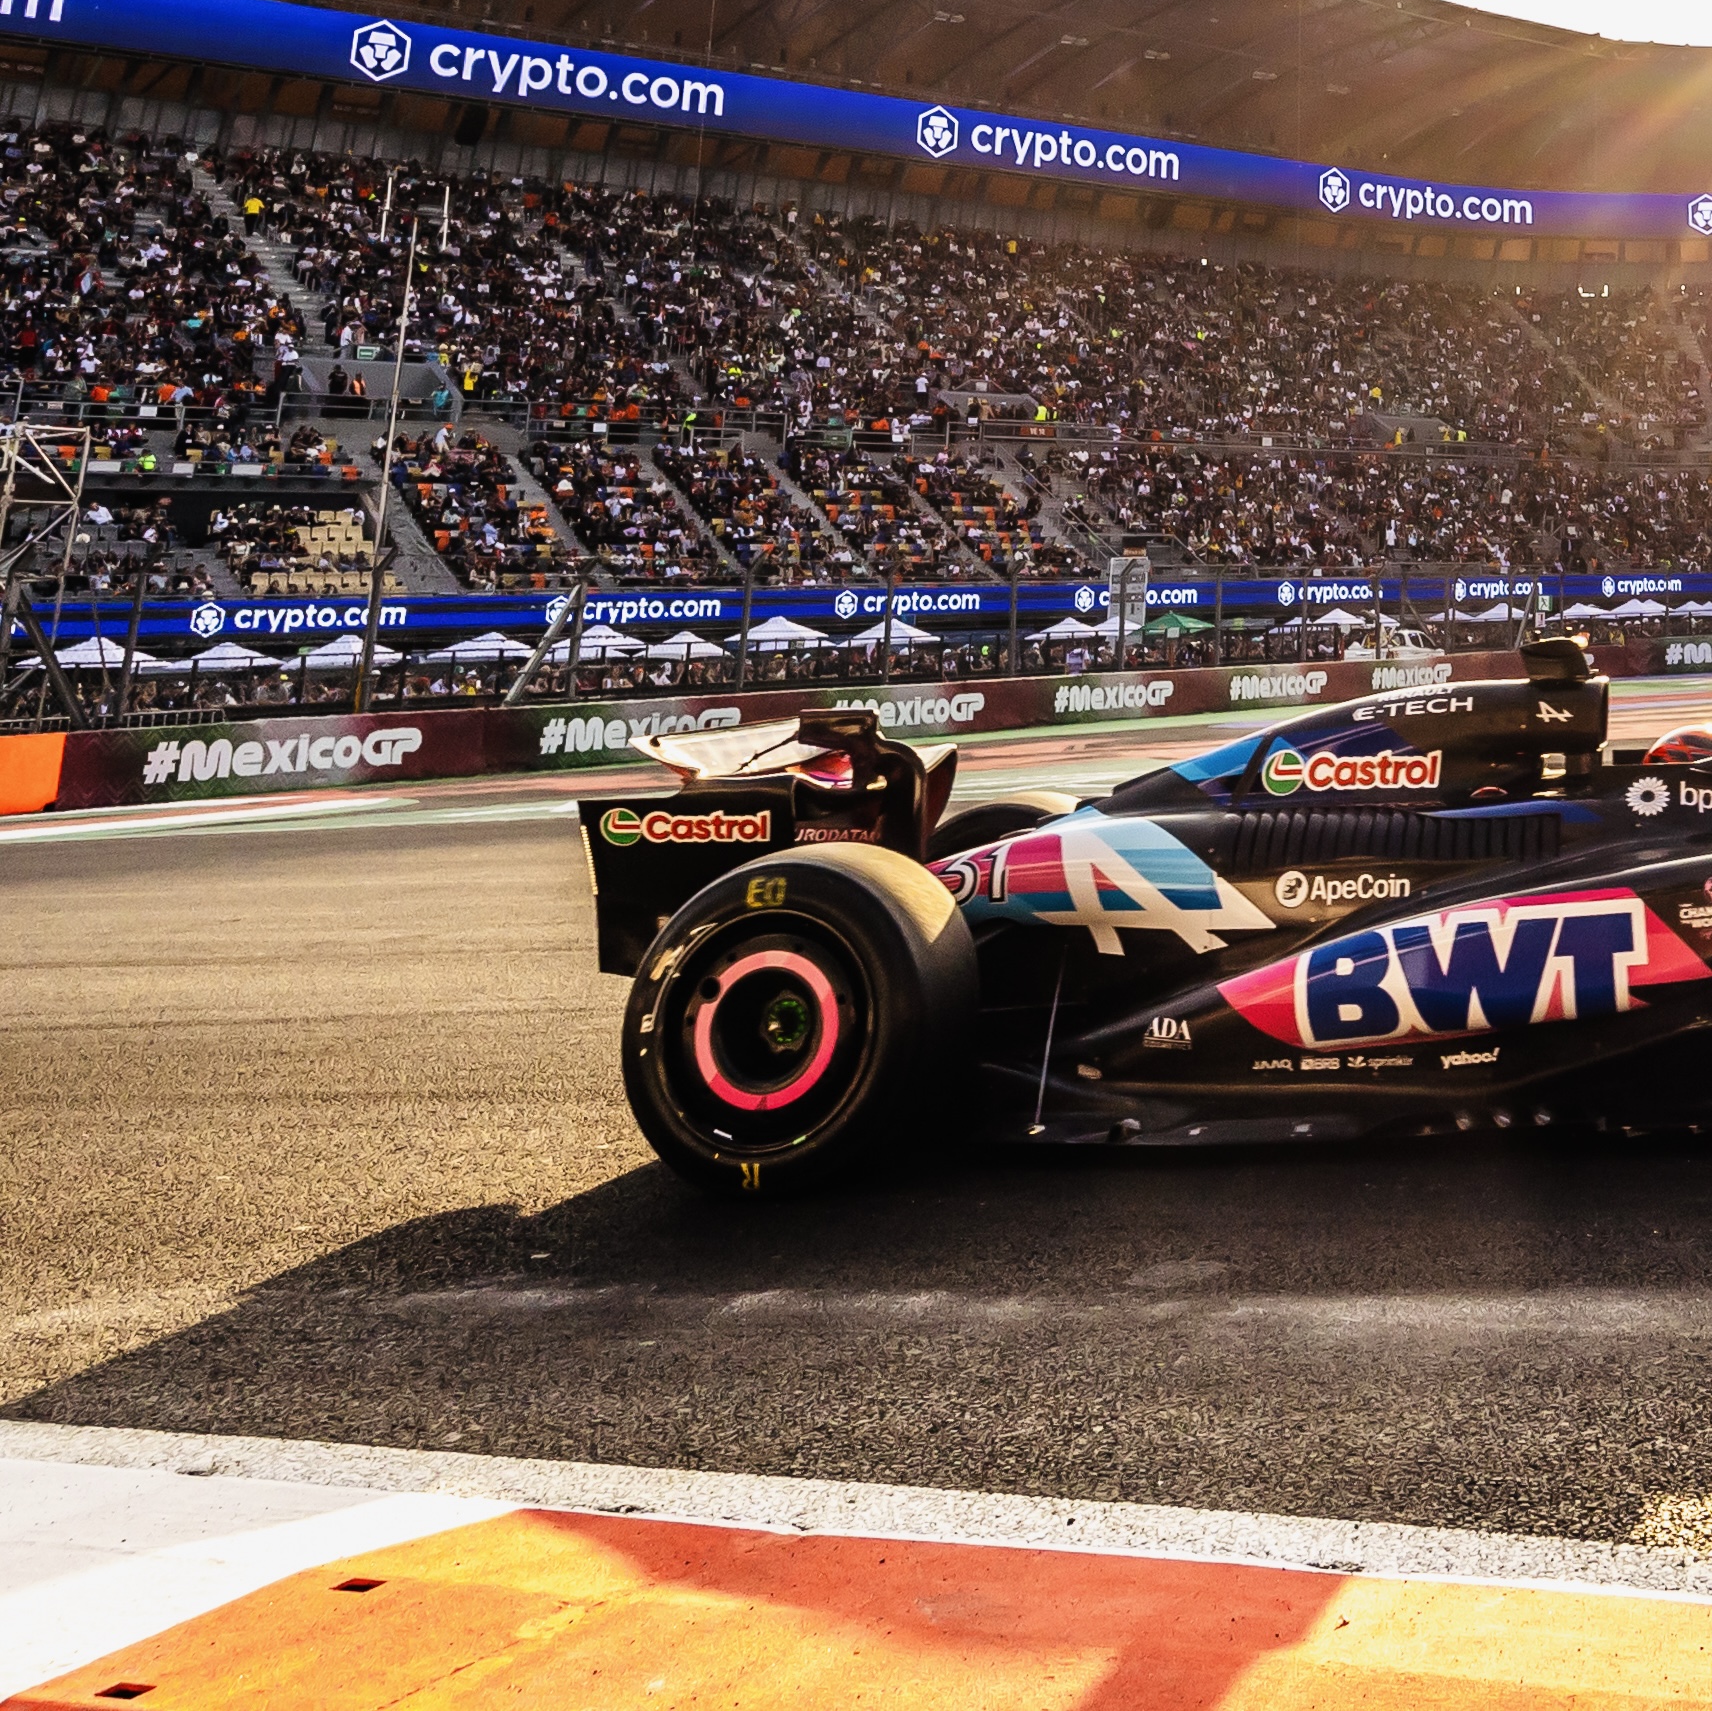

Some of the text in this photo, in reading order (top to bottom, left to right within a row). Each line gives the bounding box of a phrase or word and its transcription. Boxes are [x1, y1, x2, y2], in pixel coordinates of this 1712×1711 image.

[429, 42, 725, 116] crypto.com
[970, 122, 1181, 181] crypto.com
[1358, 179, 1534, 225] crypto.com
[583, 597, 721, 624] crypto.com
[1230, 670, 1327, 701] #MexicoGP
[1371, 663, 1453, 690] #MexicoGP
[832, 692, 985, 728] exicoGP
[1054, 680, 1174, 712] #MexicoGP
[1352, 696, 1473, 722] E-TECH
[143, 727, 423, 785] #MexicoGP
[1304, 750, 1443, 791] Castrol
[642, 809, 772, 843] Castrol
[1310, 873, 1411, 906] ApeCoin
[1297, 900, 1648, 1049] BWT
[1440, 1046, 1501, 1070] yahoo!
